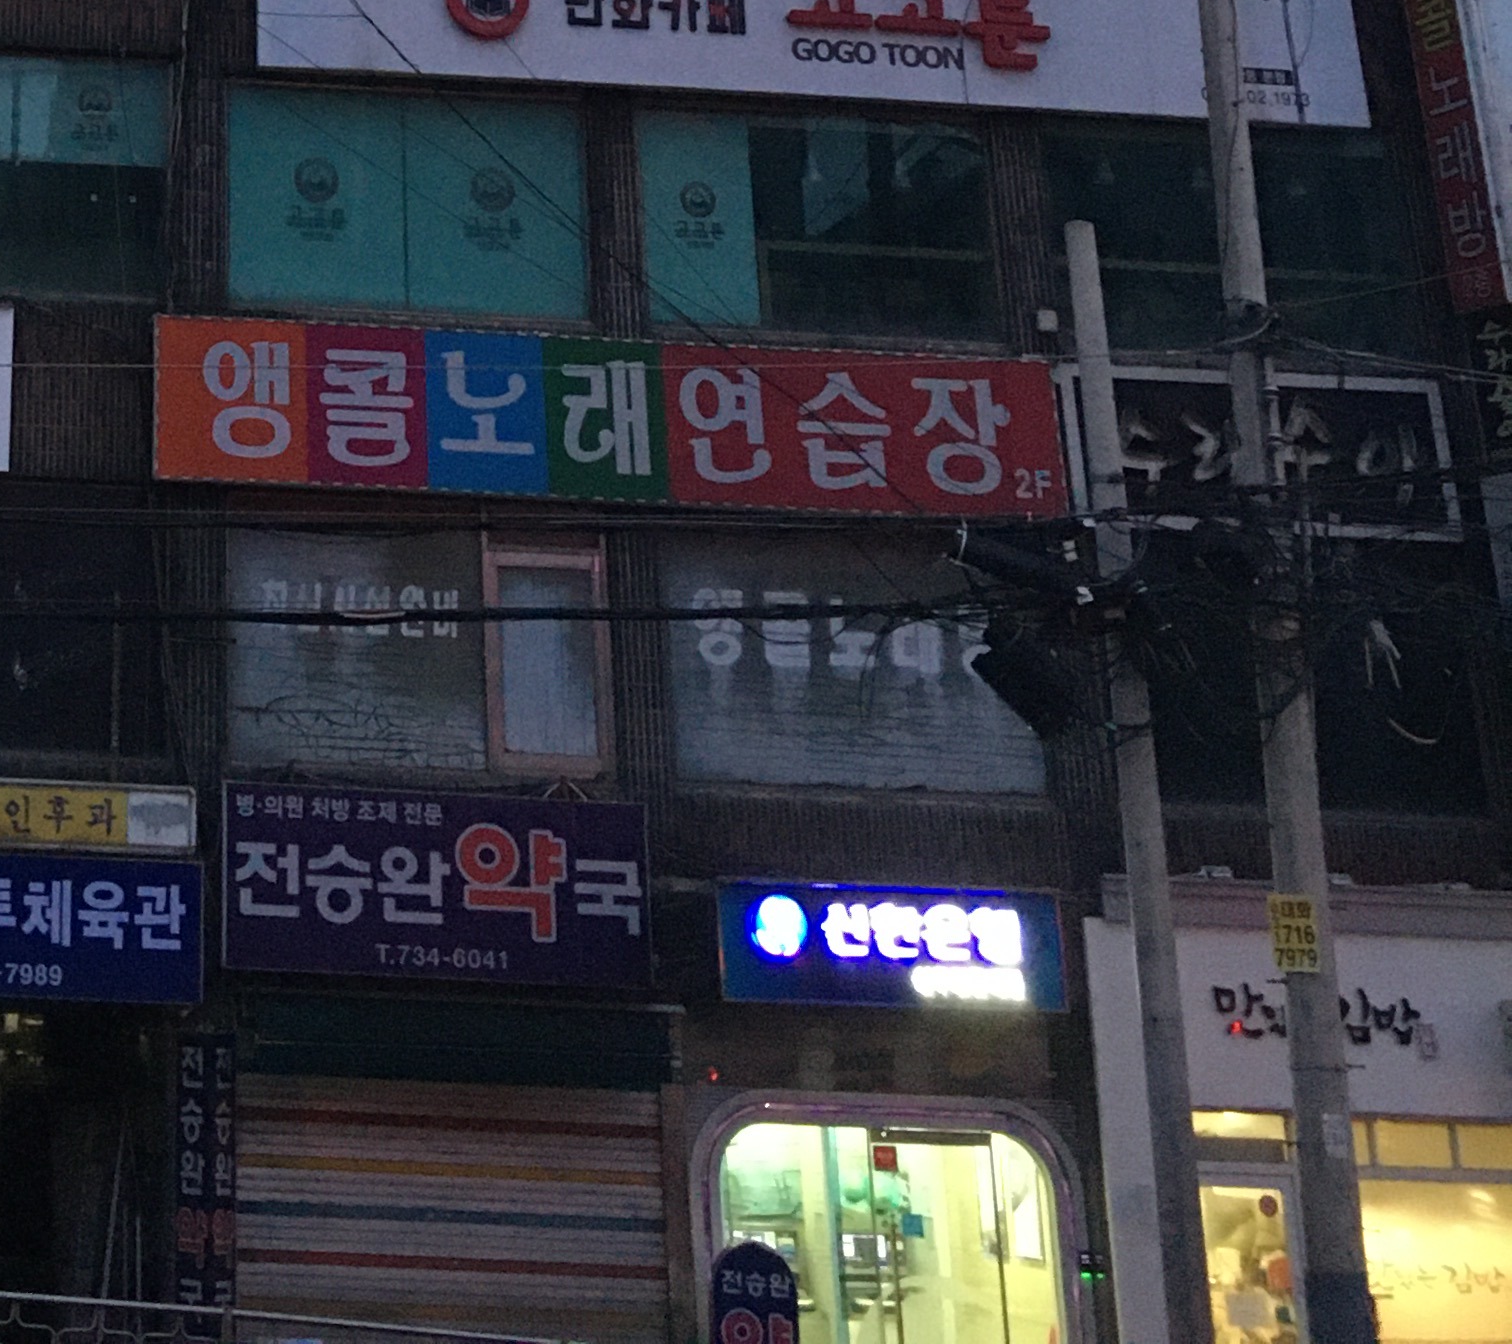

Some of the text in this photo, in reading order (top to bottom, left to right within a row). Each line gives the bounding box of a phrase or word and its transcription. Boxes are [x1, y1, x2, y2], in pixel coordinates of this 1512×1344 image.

[791, 38, 965, 71] GOGO TOON
[1014, 467, 1054, 501] 2F
[311, 796, 351, 821] 처방
[355, 799, 398, 823] 조제
[403, 801, 444, 827] 전문
[375, 943, 510, 970] T.734-6041
[719, 1268, 792, 1299] 전승완
